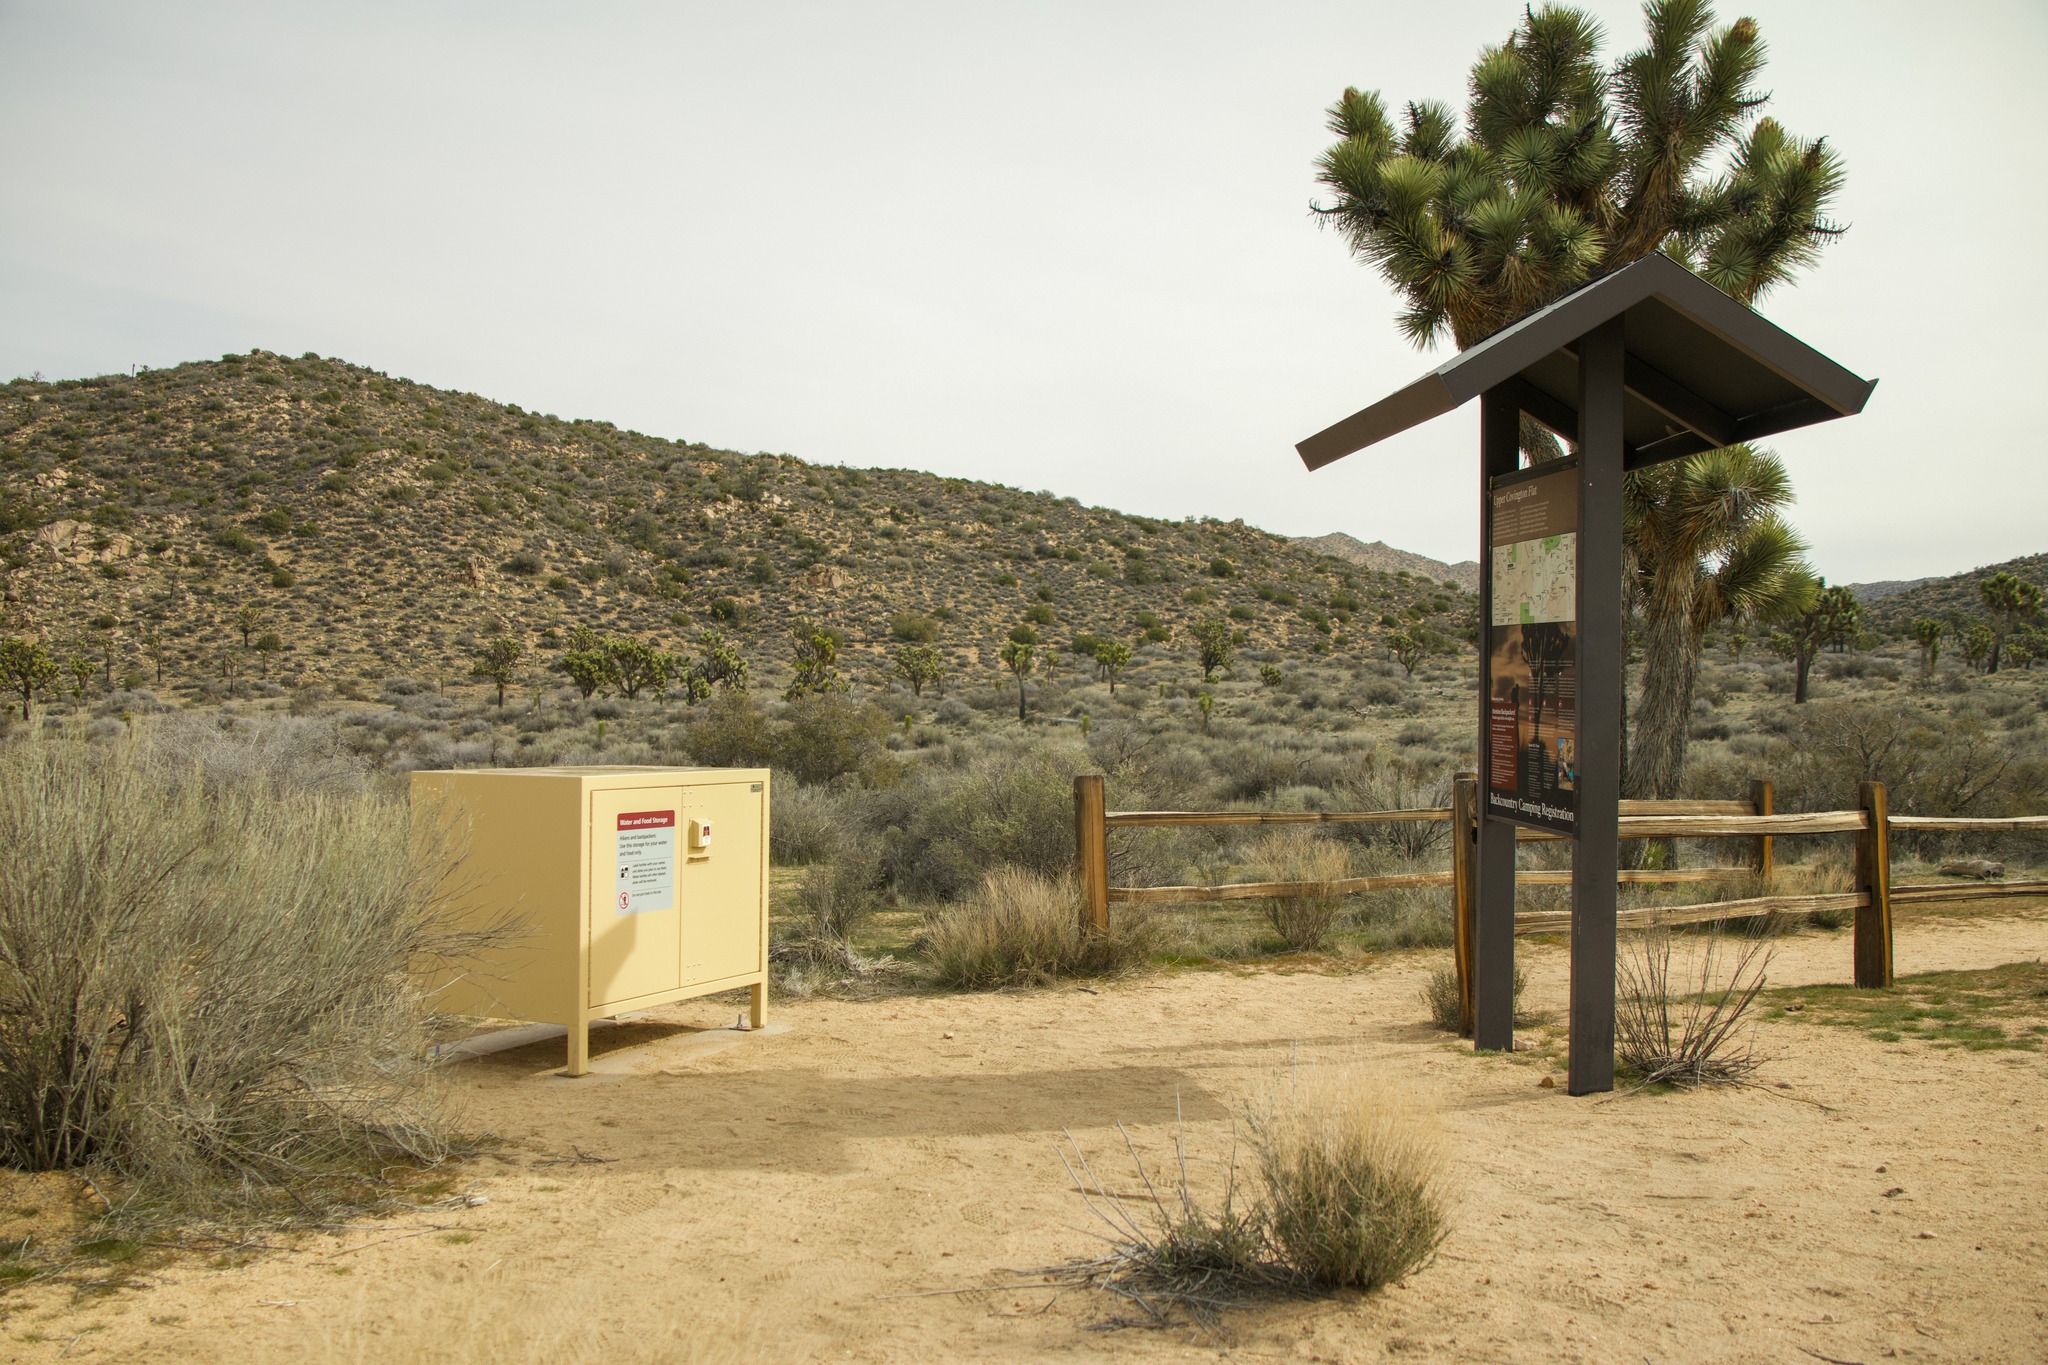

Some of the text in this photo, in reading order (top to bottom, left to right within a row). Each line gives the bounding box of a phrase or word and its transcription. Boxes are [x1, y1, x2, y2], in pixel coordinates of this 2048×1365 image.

[1493, 495, 1506, 508] Upper
[1506, 490, 1528, 503] Covington
[1490, 792, 1574, 822] Backcountry Camping Registration
[652, 817, 668, 825] Storage
